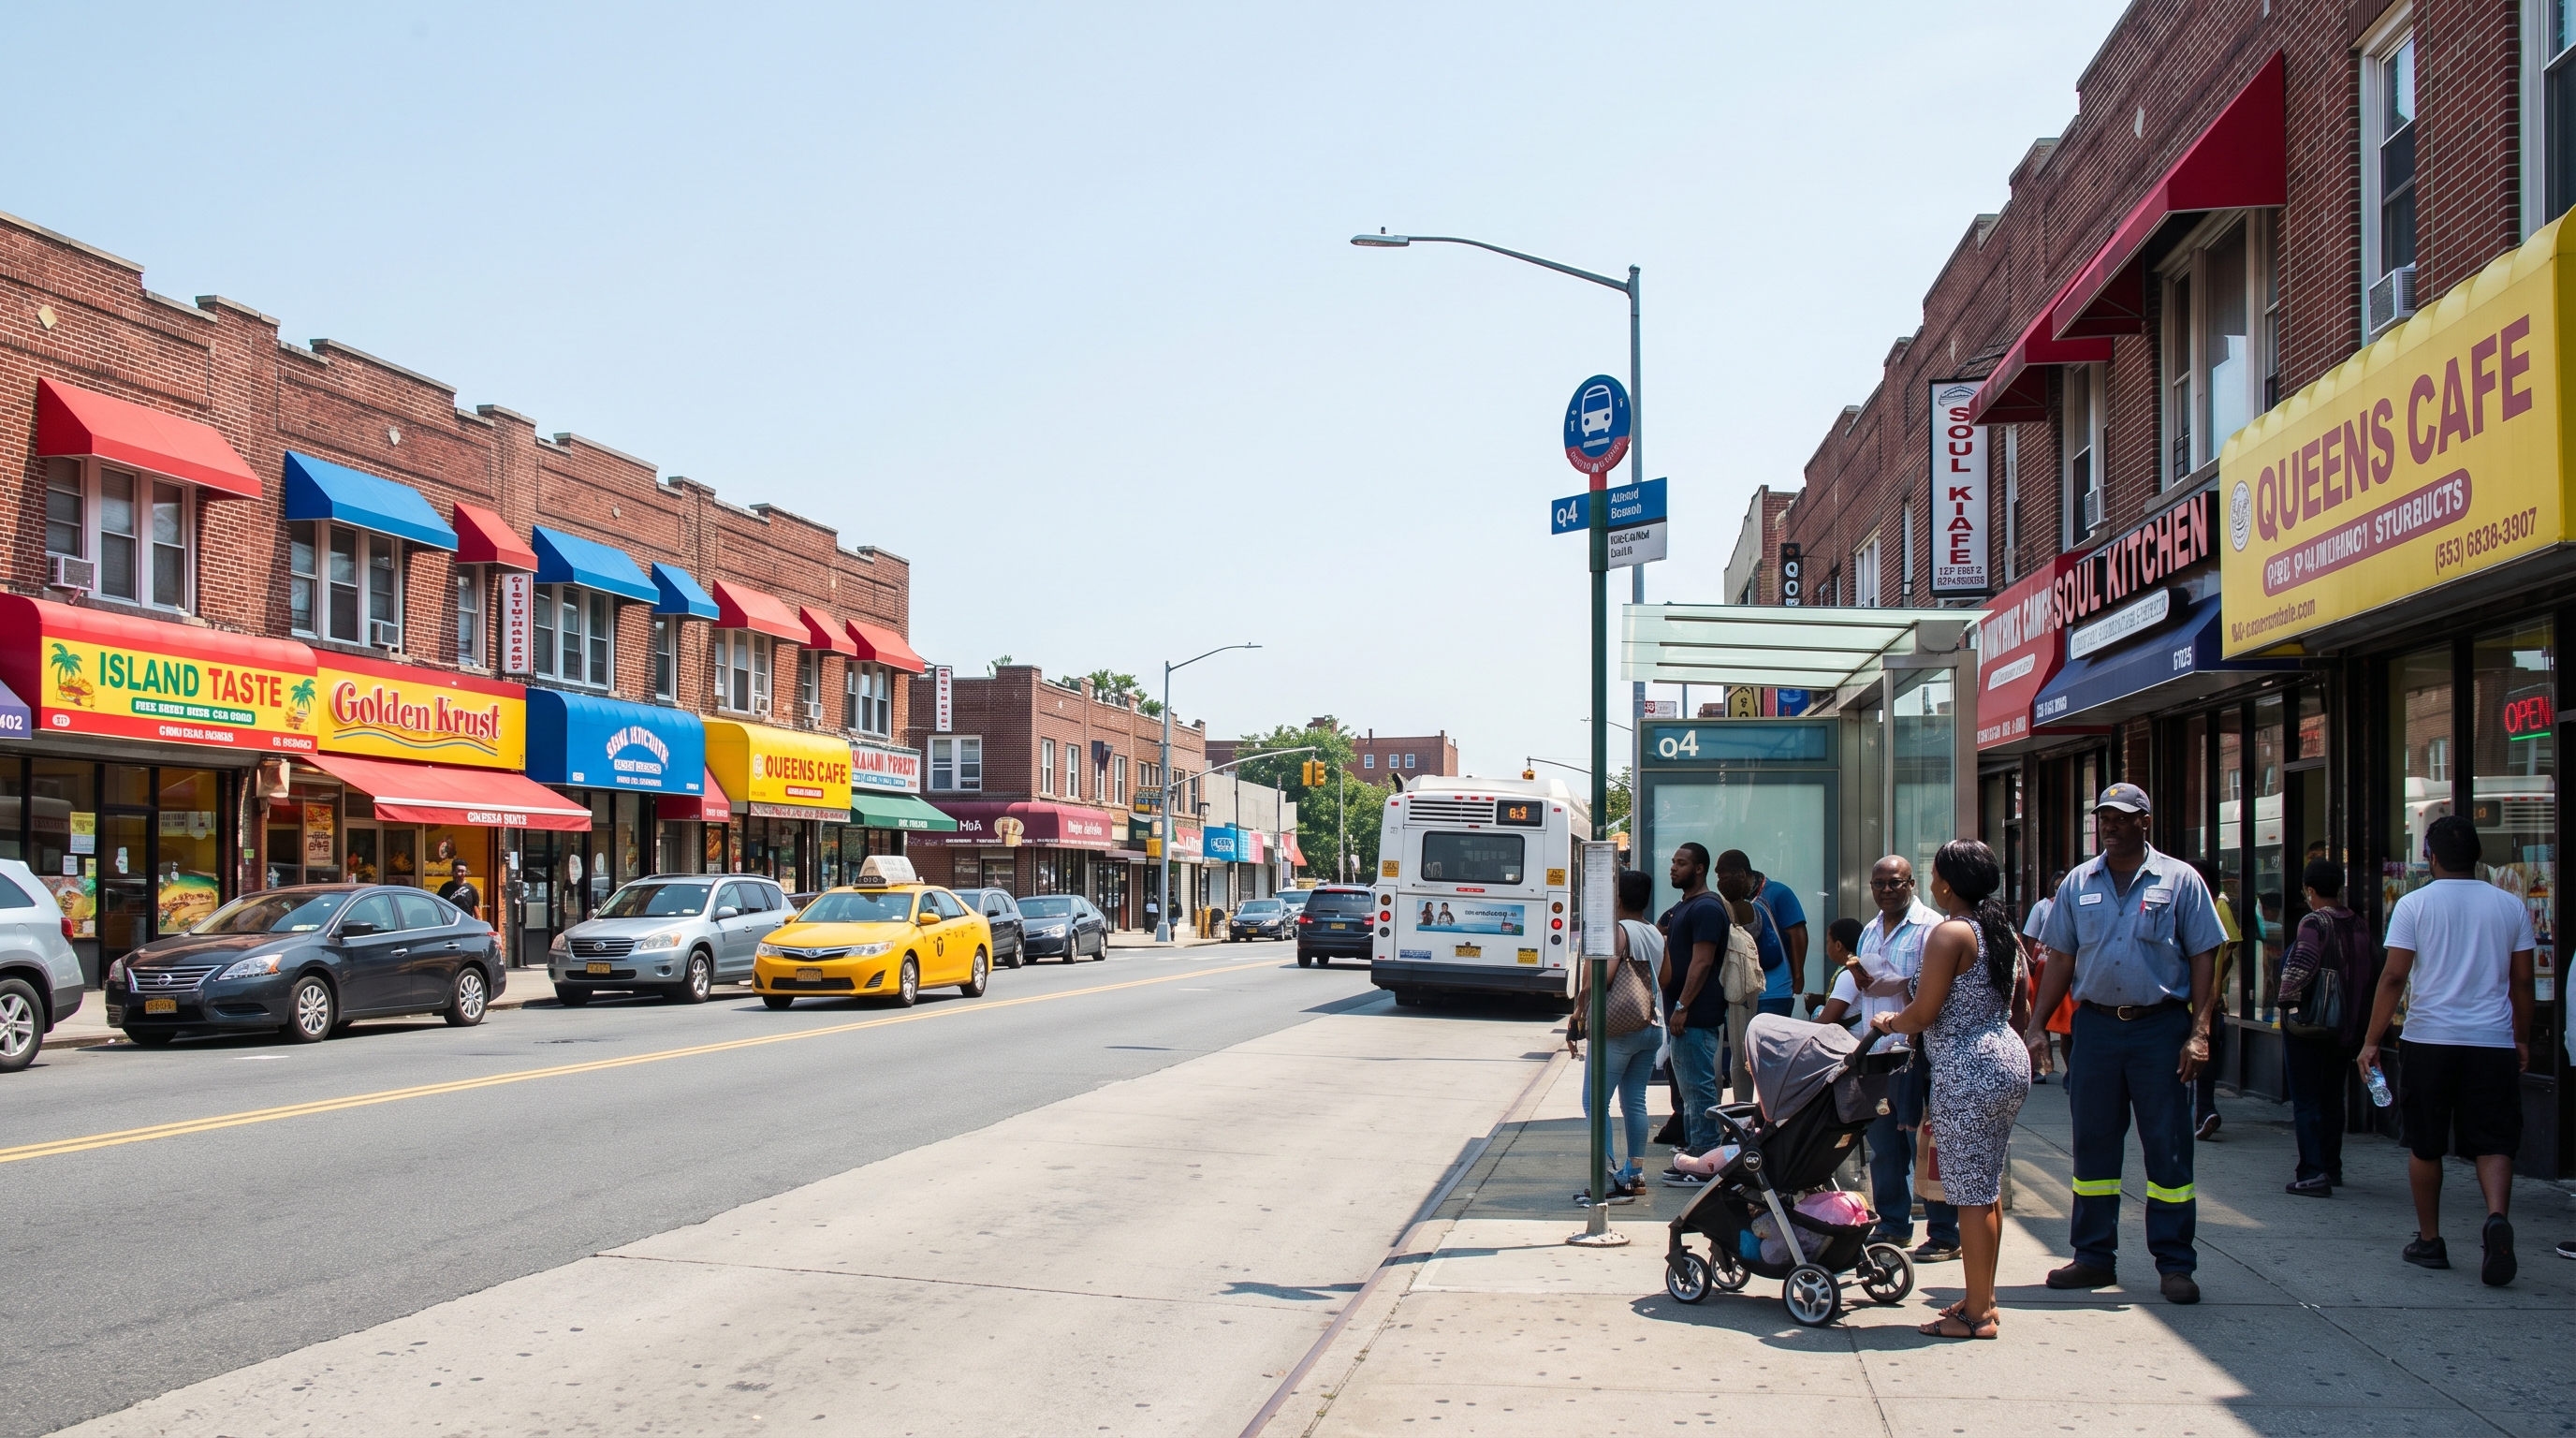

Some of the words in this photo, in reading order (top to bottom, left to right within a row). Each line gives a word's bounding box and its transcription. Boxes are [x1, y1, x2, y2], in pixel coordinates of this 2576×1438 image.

[1947, 406, 1974, 473] SOUL
[2257, 397, 2395, 543] QUEENS
[2407, 314, 2533, 465] CAFE
[1947, 486, 1974, 565] KIAFE
[2435, 536, 2464, 576] (553)
[2466, 506, 2538, 559] 6838-3907
[2053, 557, 2101, 630] SOUL
[2106, 491, 2208, 605] KITCHEN
[99, 652, 199, 697] ISLAND
[208, 668, 283, 708] TASTE
[332, 681, 432, 732] Golden
[434, 696, 502, 741] Krust
[2504, 696, 2551, 734] OPEN
[766, 755, 815, 782] QUEENS
[817, 760, 846, 785] CAFE
